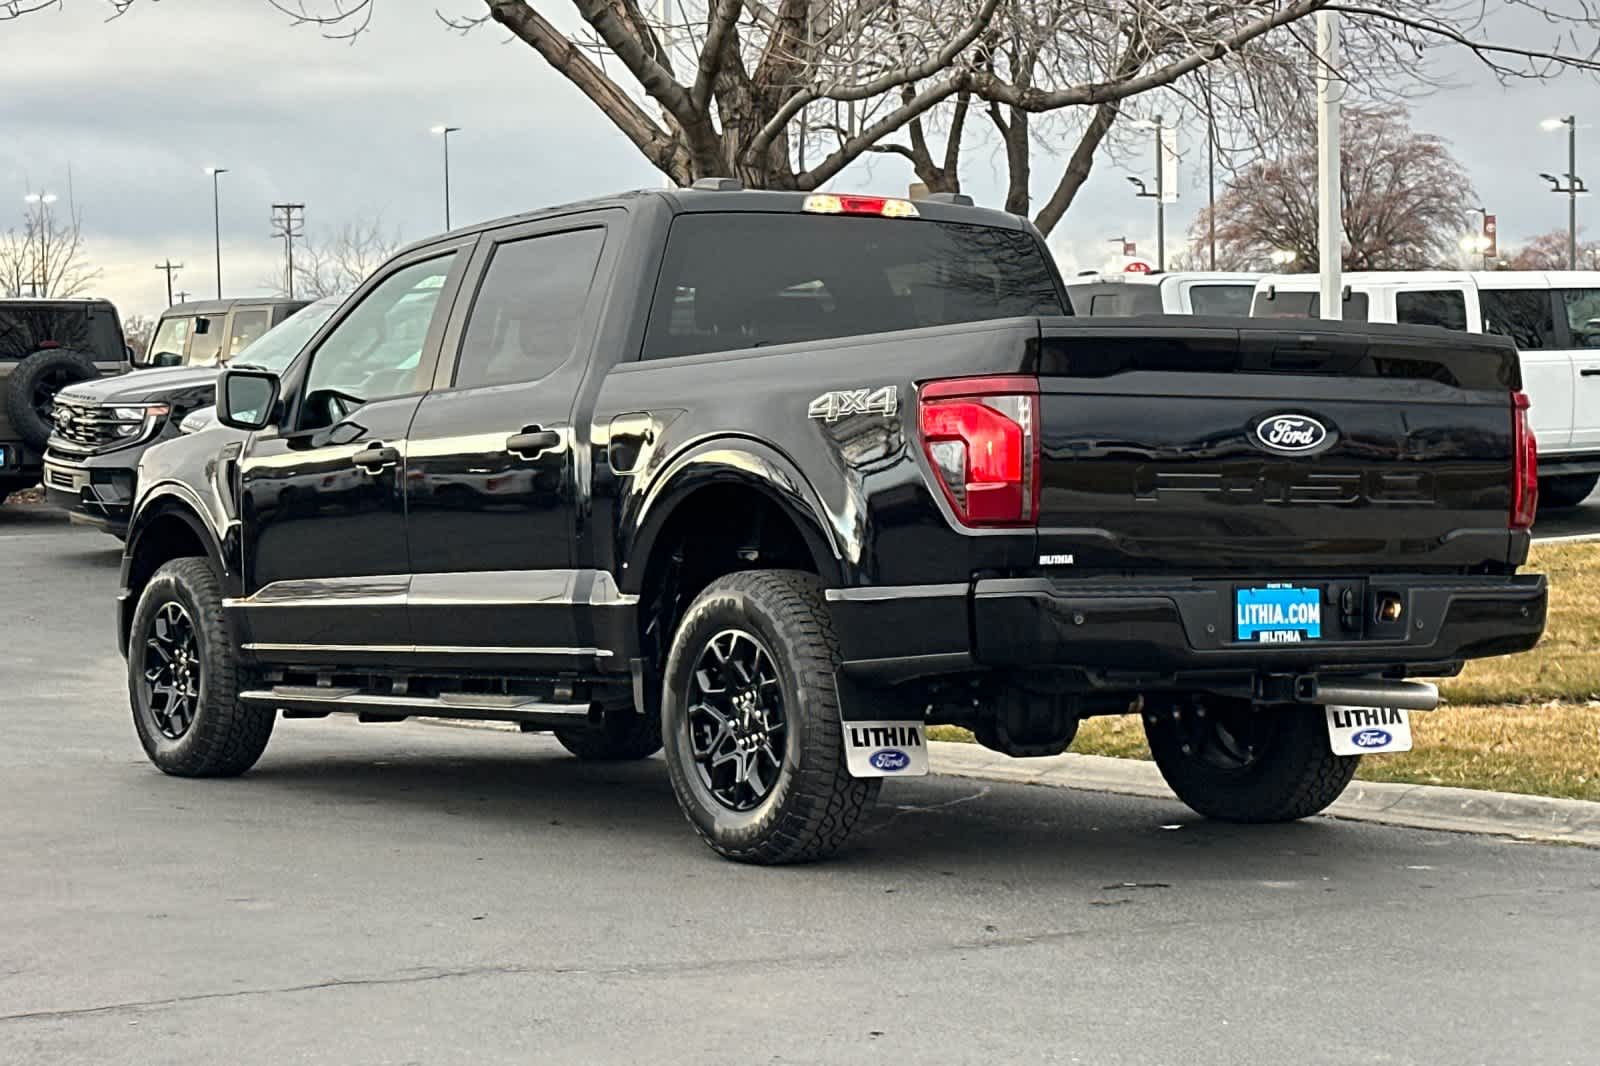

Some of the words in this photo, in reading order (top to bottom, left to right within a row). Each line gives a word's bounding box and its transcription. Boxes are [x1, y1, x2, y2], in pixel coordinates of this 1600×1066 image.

[1269, 419, 1315, 445] Ford
[1238, 603, 1320, 625] LITHIA.COM
[1270, 631, 1301, 642] LITHIA
[1333, 707, 1402, 728] LITHIA
[851, 727, 921, 747] LITHIA
[1358, 732, 1387, 746] Ford
[875, 753, 904, 768] Ford
